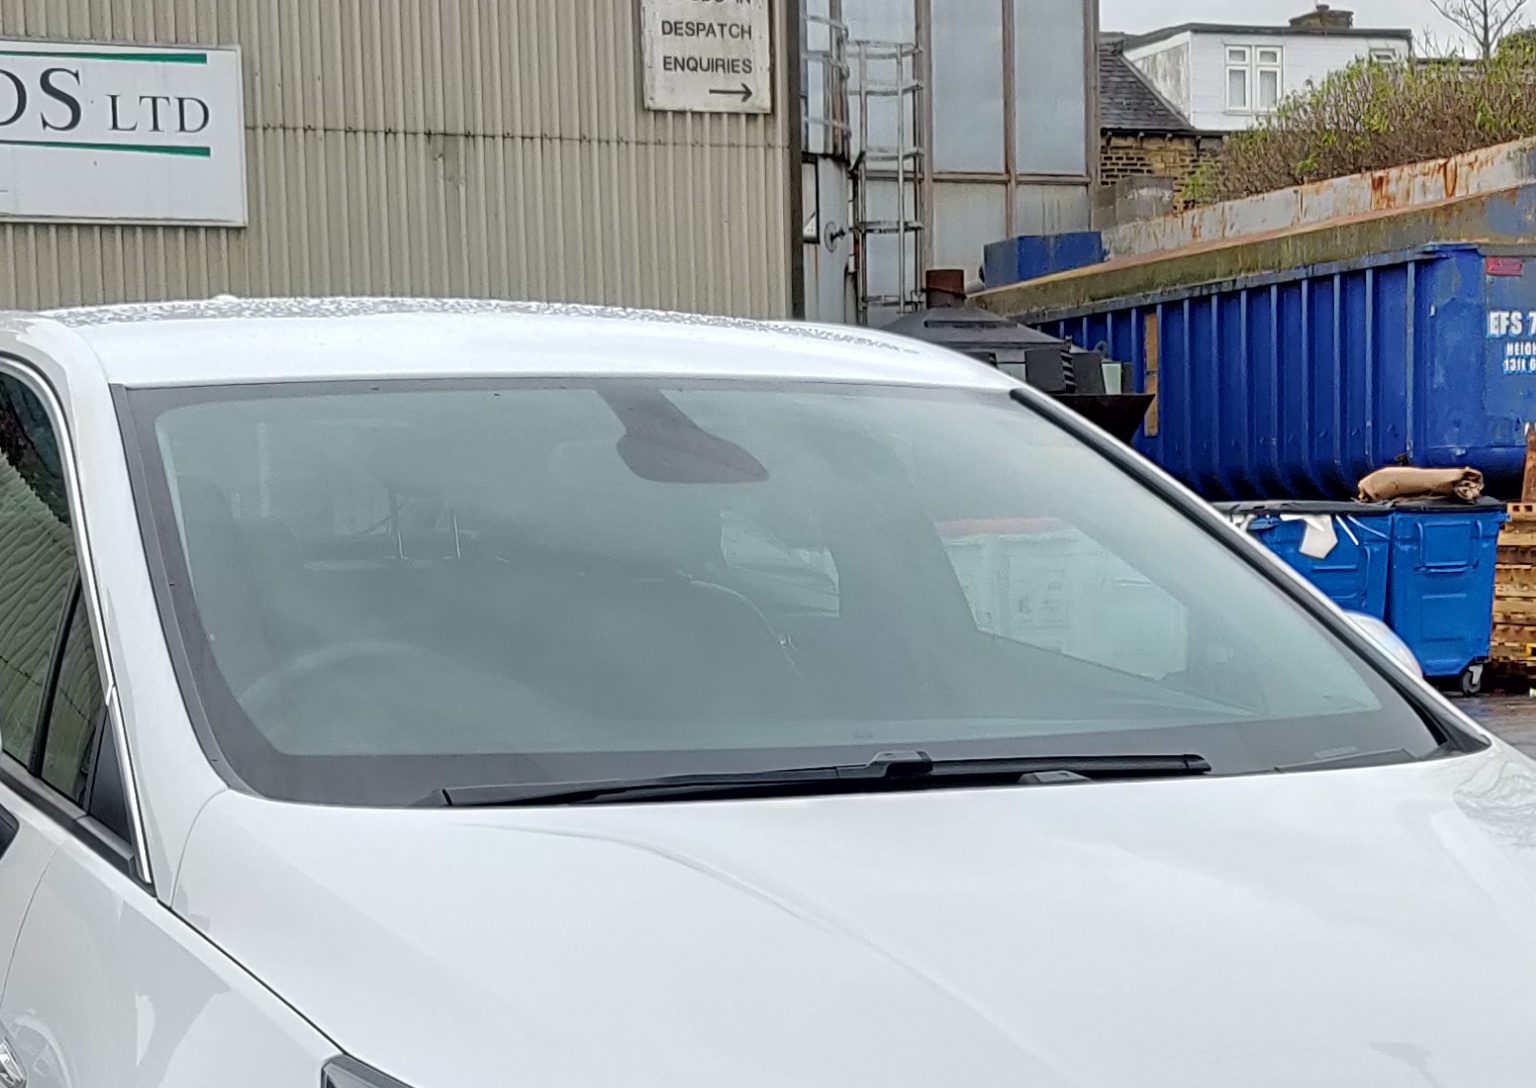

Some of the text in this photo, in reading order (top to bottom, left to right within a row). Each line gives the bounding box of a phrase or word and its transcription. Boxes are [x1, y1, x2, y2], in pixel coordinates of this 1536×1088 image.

[661, 19, 752, 40] DESPATCH
[662, 55, 753, 74] ENQUIRIES
[105, 93, 211, 134] LTD
[1488, 310, 1523, 336] EFS
